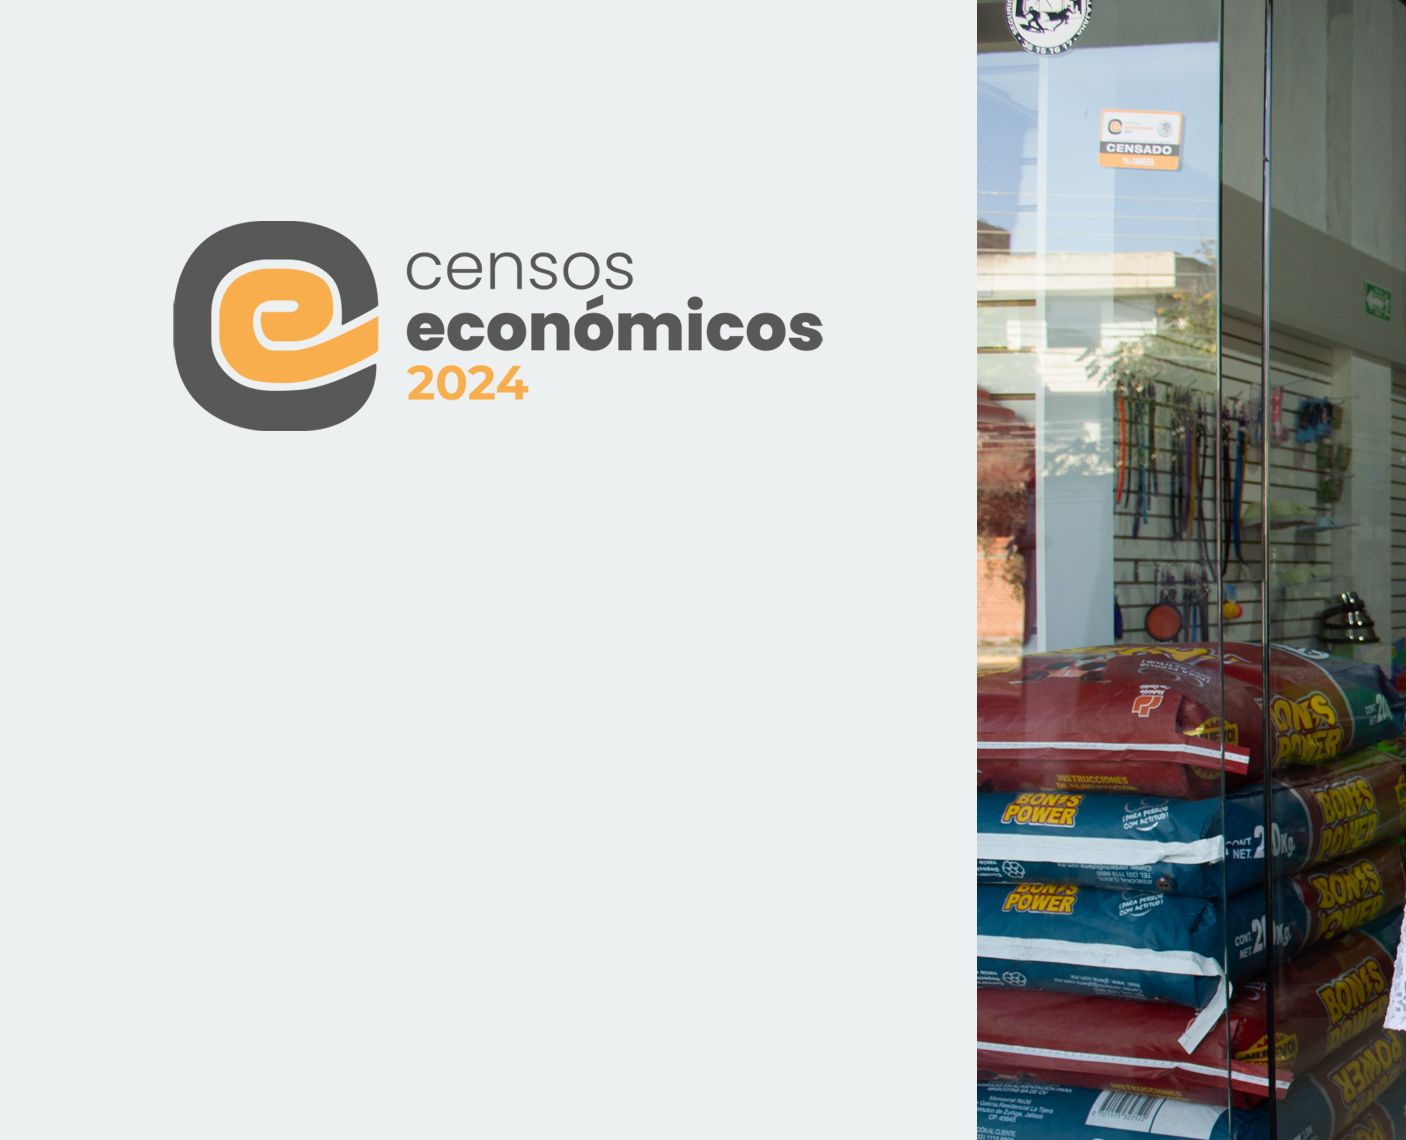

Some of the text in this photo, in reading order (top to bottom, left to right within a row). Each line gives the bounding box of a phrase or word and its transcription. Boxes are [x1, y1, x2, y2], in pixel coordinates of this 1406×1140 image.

[1035, 45, 1047, 55] 15
[1049, 46, 1061, 55] 16
[1062, 40, 1073, 50] 17
[1106, 142, 1173, 156] CENSADO
[1133, 157, 1155, 167] INEGI
[1056, 774, 1129, 785] INSTRUCCIONES
[1002, 804, 1077, 825] POWER
[1123, 819, 1138, 830] CON
[1315, 813, 1378, 862] POWER
[1232, 848, 1253, 860] NET.
[1003, 893, 1076, 913] POWER
[1234, 931, 1253, 947] CONT.
[1239, 946, 1253, 960] NET.
[1110, 1083, 1183, 1097] INSTRUCCIONES
